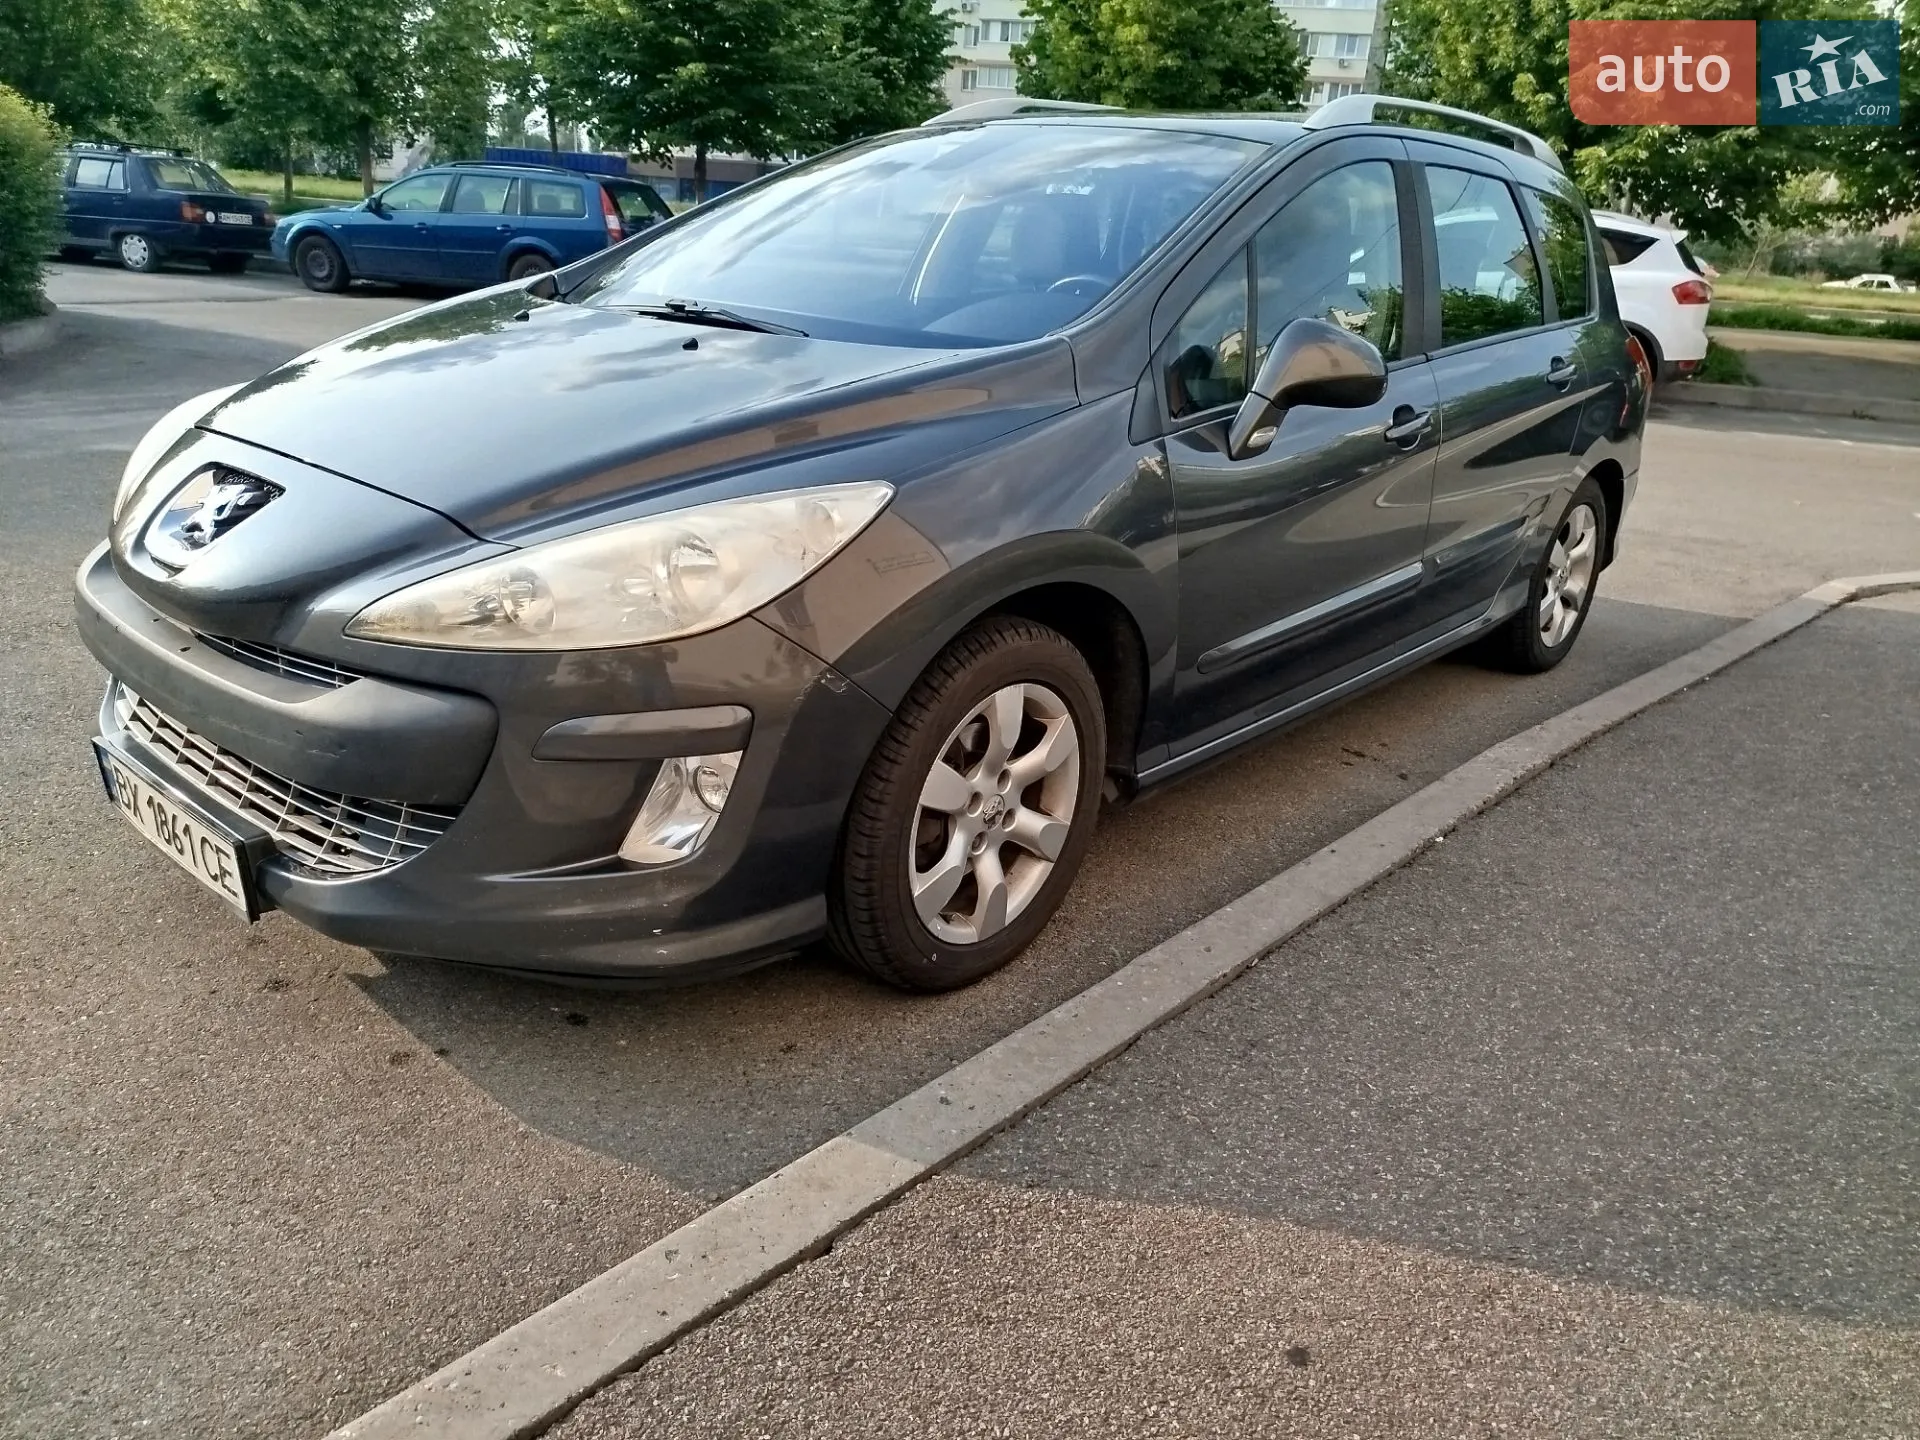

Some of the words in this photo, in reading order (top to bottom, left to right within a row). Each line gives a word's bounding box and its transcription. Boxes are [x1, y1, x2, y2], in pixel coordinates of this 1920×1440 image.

[113, 765, 146, 826] BX
[146, 794, 199, 869] 1861
[200, 836, 240, 899] CE
